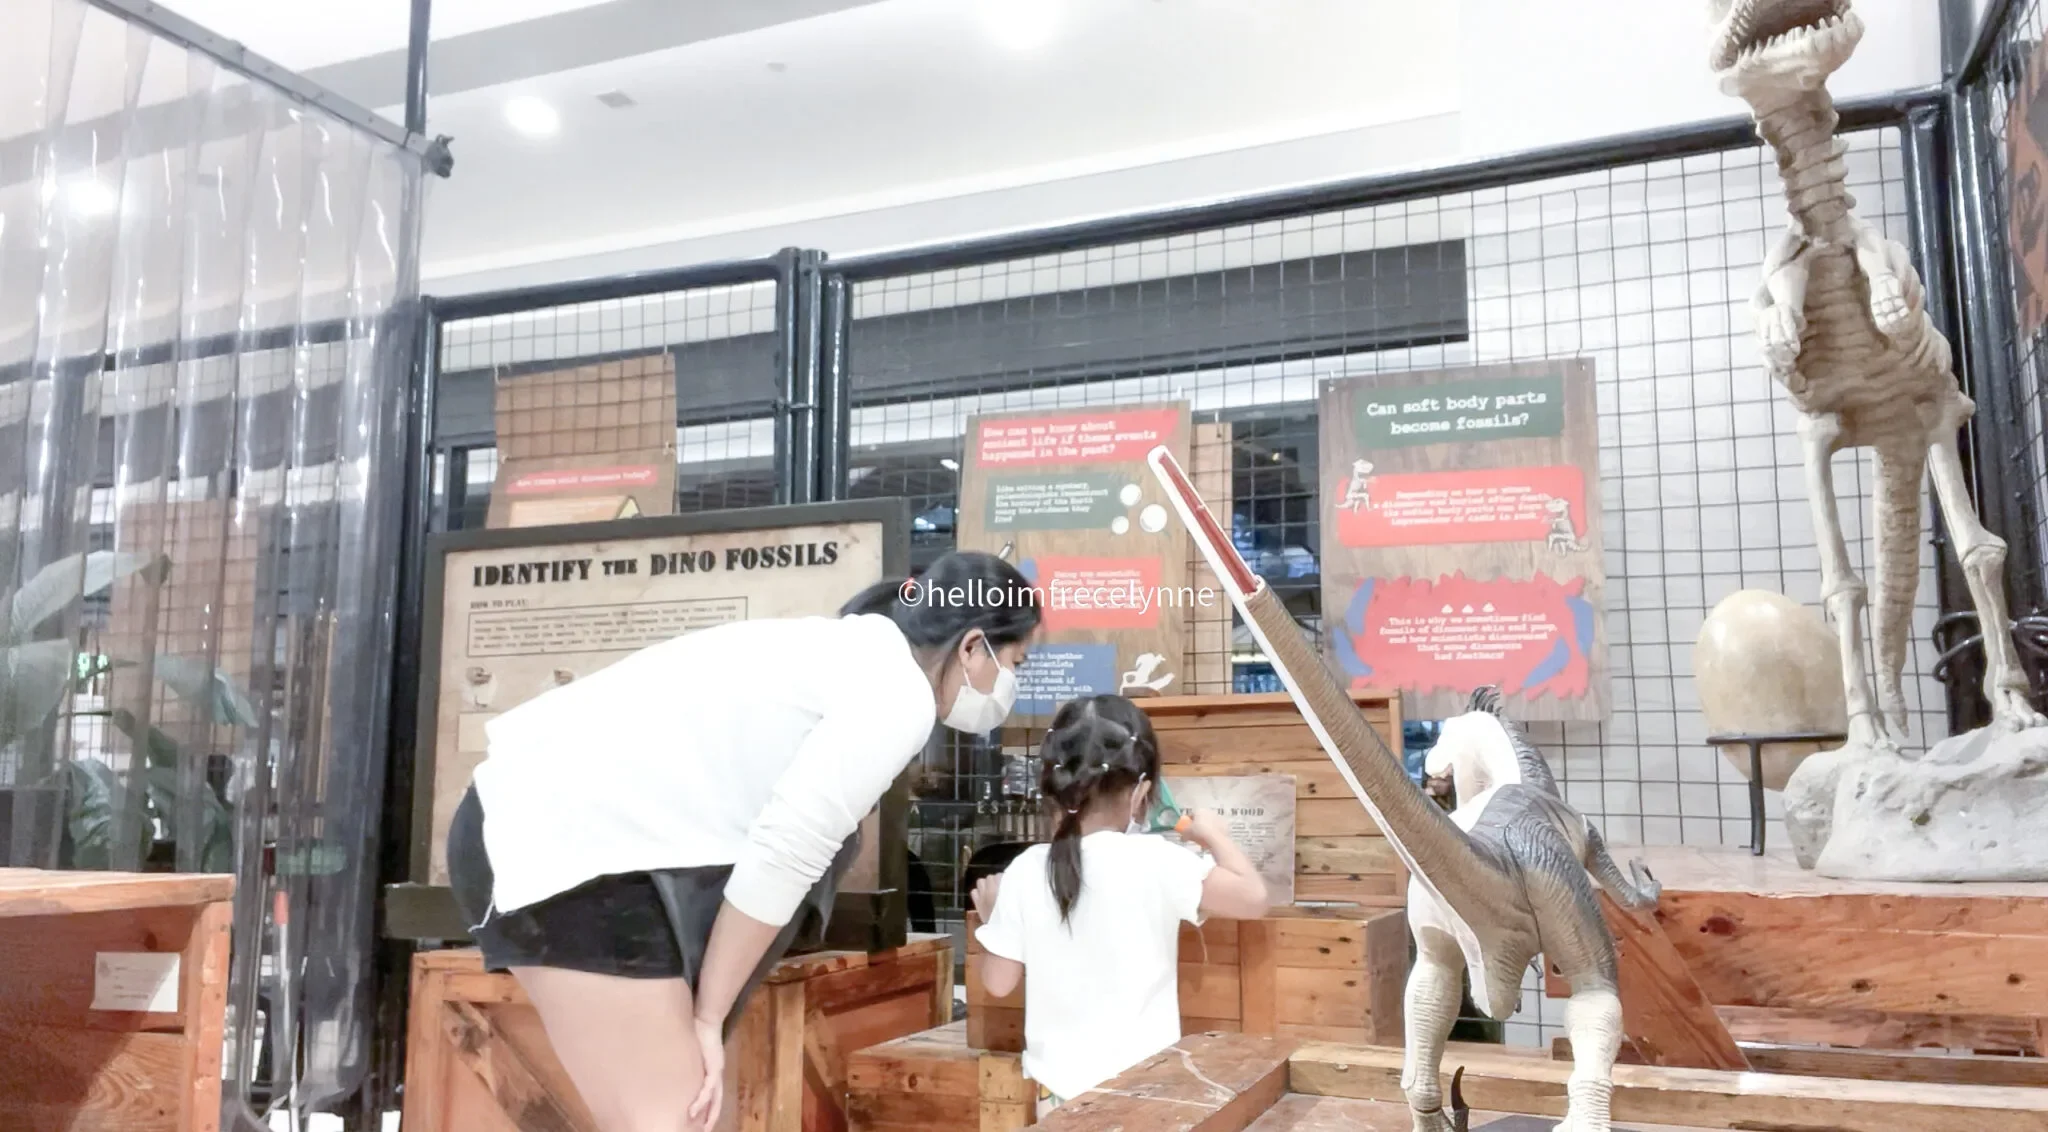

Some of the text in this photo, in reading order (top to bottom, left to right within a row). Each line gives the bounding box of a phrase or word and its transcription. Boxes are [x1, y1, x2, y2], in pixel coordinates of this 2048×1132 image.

[1366, 391, 1547, 416] Can soft body parts
[984, 420, 1116, 438] How can we know about
[1390, 412, 1529, 435] become fossils?
[983, 437, 1027, 449] ancient
[1032, 434, 1057, 446] life
[1060, 433, 1074, 445] if
[1115, 430, 1157, 441] events
[982, 444, 1116, 462] happened in the past?
[473, 542, 838, 587] IDENTIFY THE DINO FOSSILS
[1230, 808, 1265, 816] WOOD
